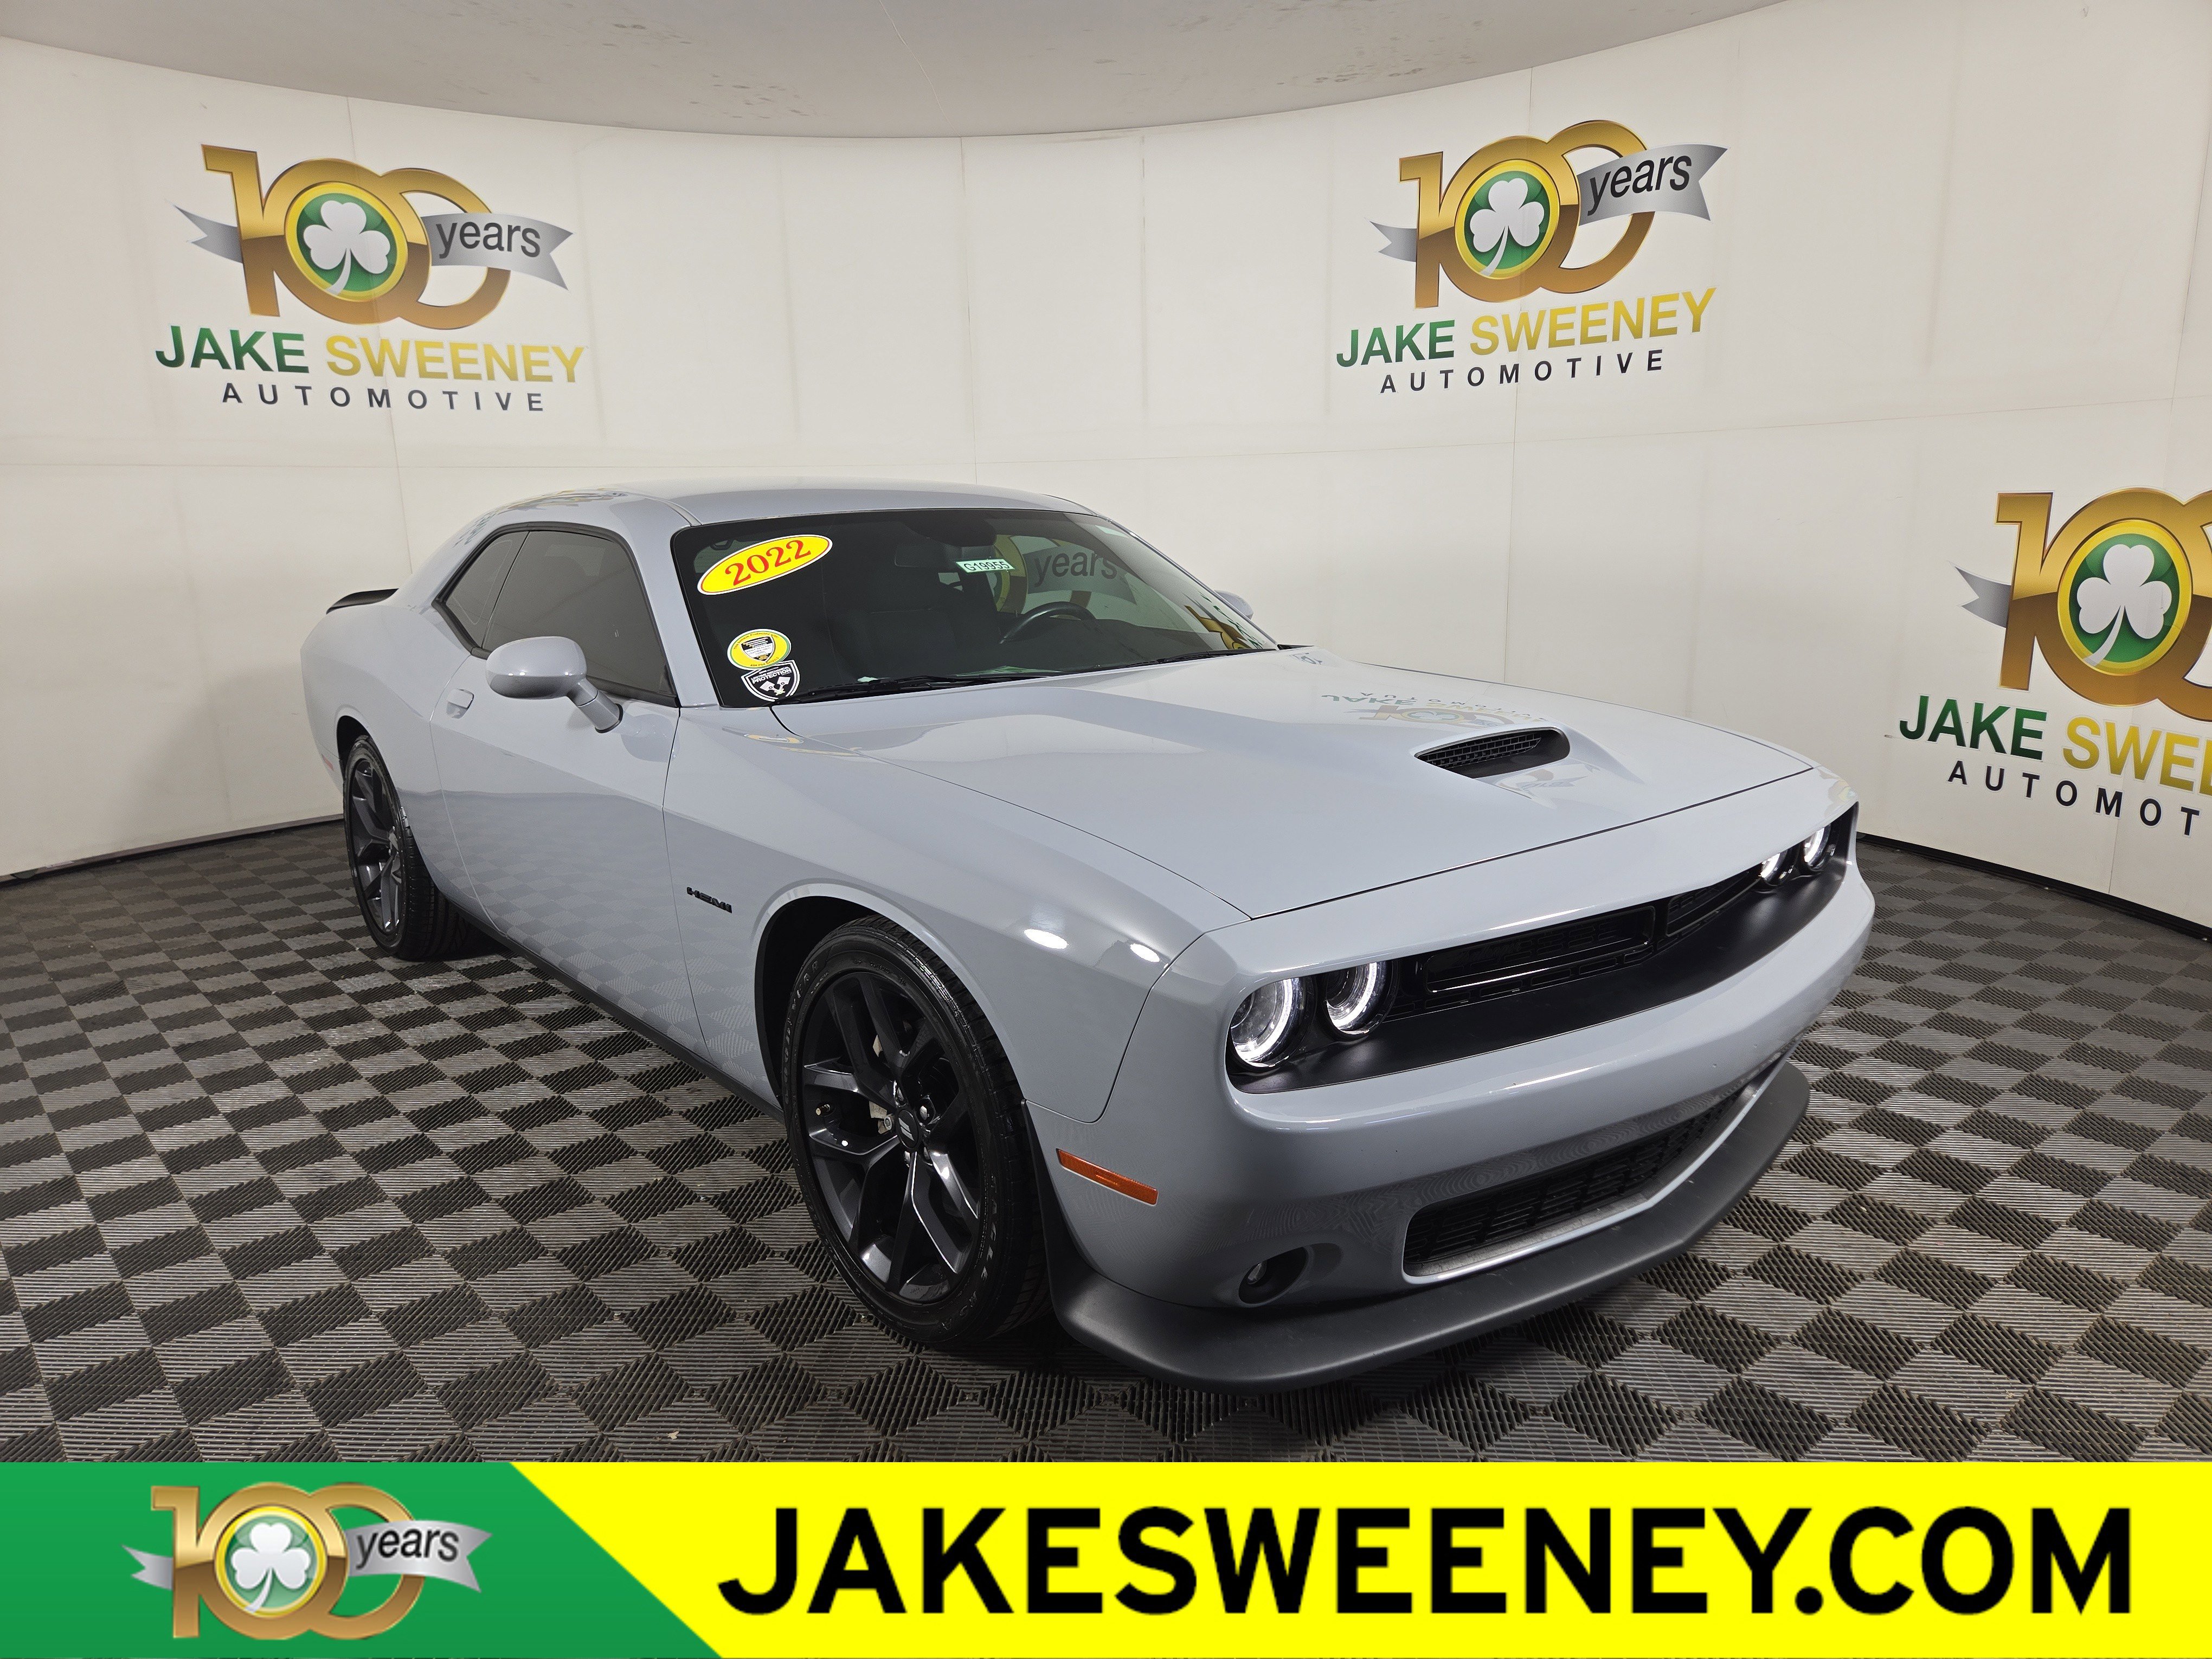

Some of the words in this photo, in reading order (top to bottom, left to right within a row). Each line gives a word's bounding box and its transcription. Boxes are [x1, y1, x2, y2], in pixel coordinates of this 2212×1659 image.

[1587, 154, 1693, 215] years
[436, 220, 541, 258] years
[1336, 320, 1455, 368] JAKE
[1470, 287, 1716, 356] SWEENEY
[155, 325, 310, 373] JAKE
[325, 335, 584, 382] SWEENEY
[1380, 349, 1663, 394] AUTOMOTIVE
[222, 383, 543, 411] AUTOMOTIVE
[725, 539, 812, 586] 2022
[963, 561, 1009, 571] G19955
[751, 668, 792, 684] PROTECTION
[1899, 695, 2047, 760] JAKE
[686, 886, 732, 914] HEMI
